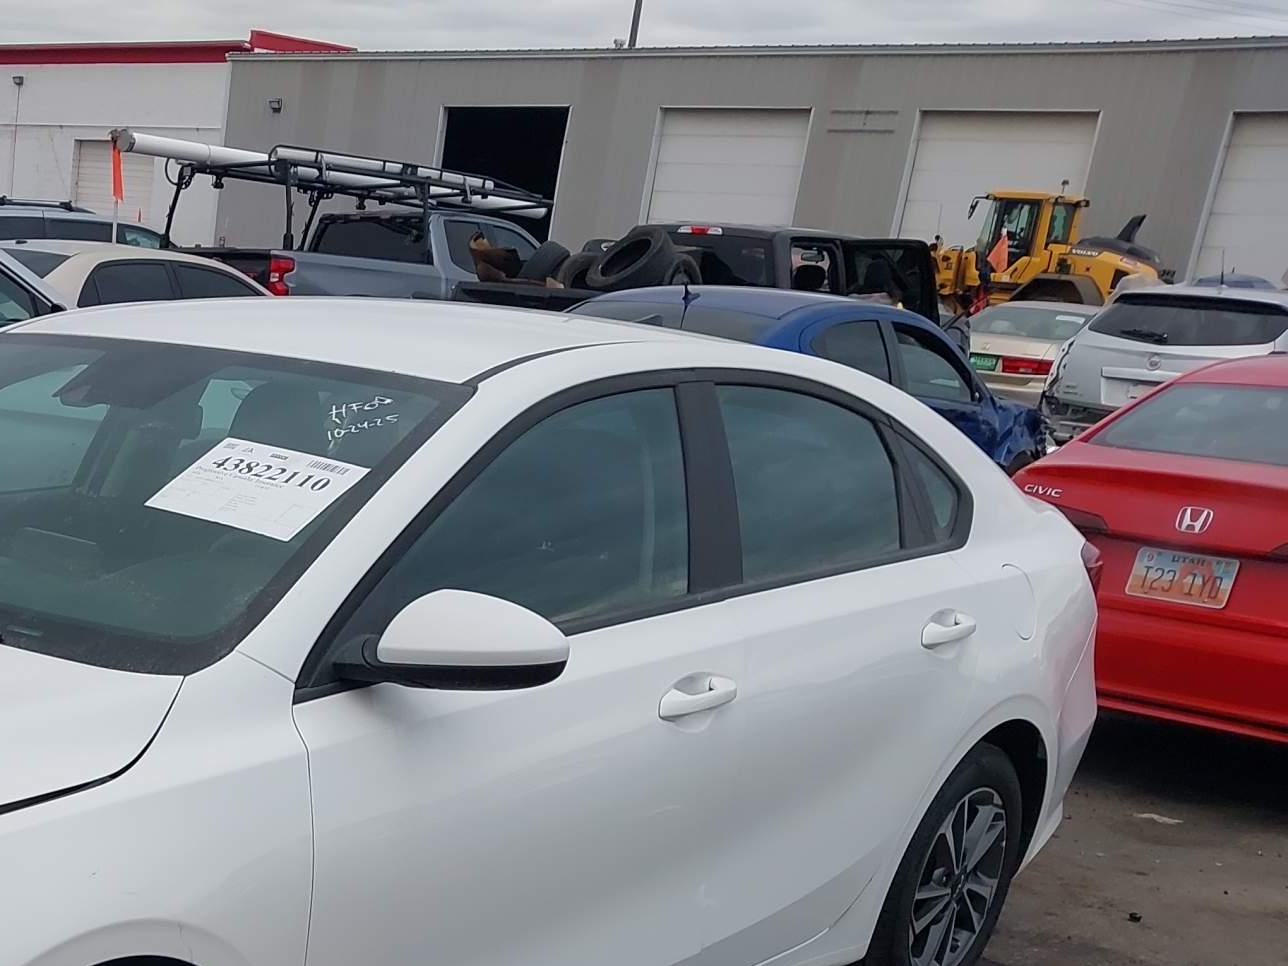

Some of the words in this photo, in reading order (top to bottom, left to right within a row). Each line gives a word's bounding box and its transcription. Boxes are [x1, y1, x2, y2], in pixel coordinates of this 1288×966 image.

[328, 414, 399, 440] 10-24-25
[212, 456, 331, 492] 43822110
[1024, 484, 1063, 497] CIVIC
[1140, 566, 1176, 592] T23
